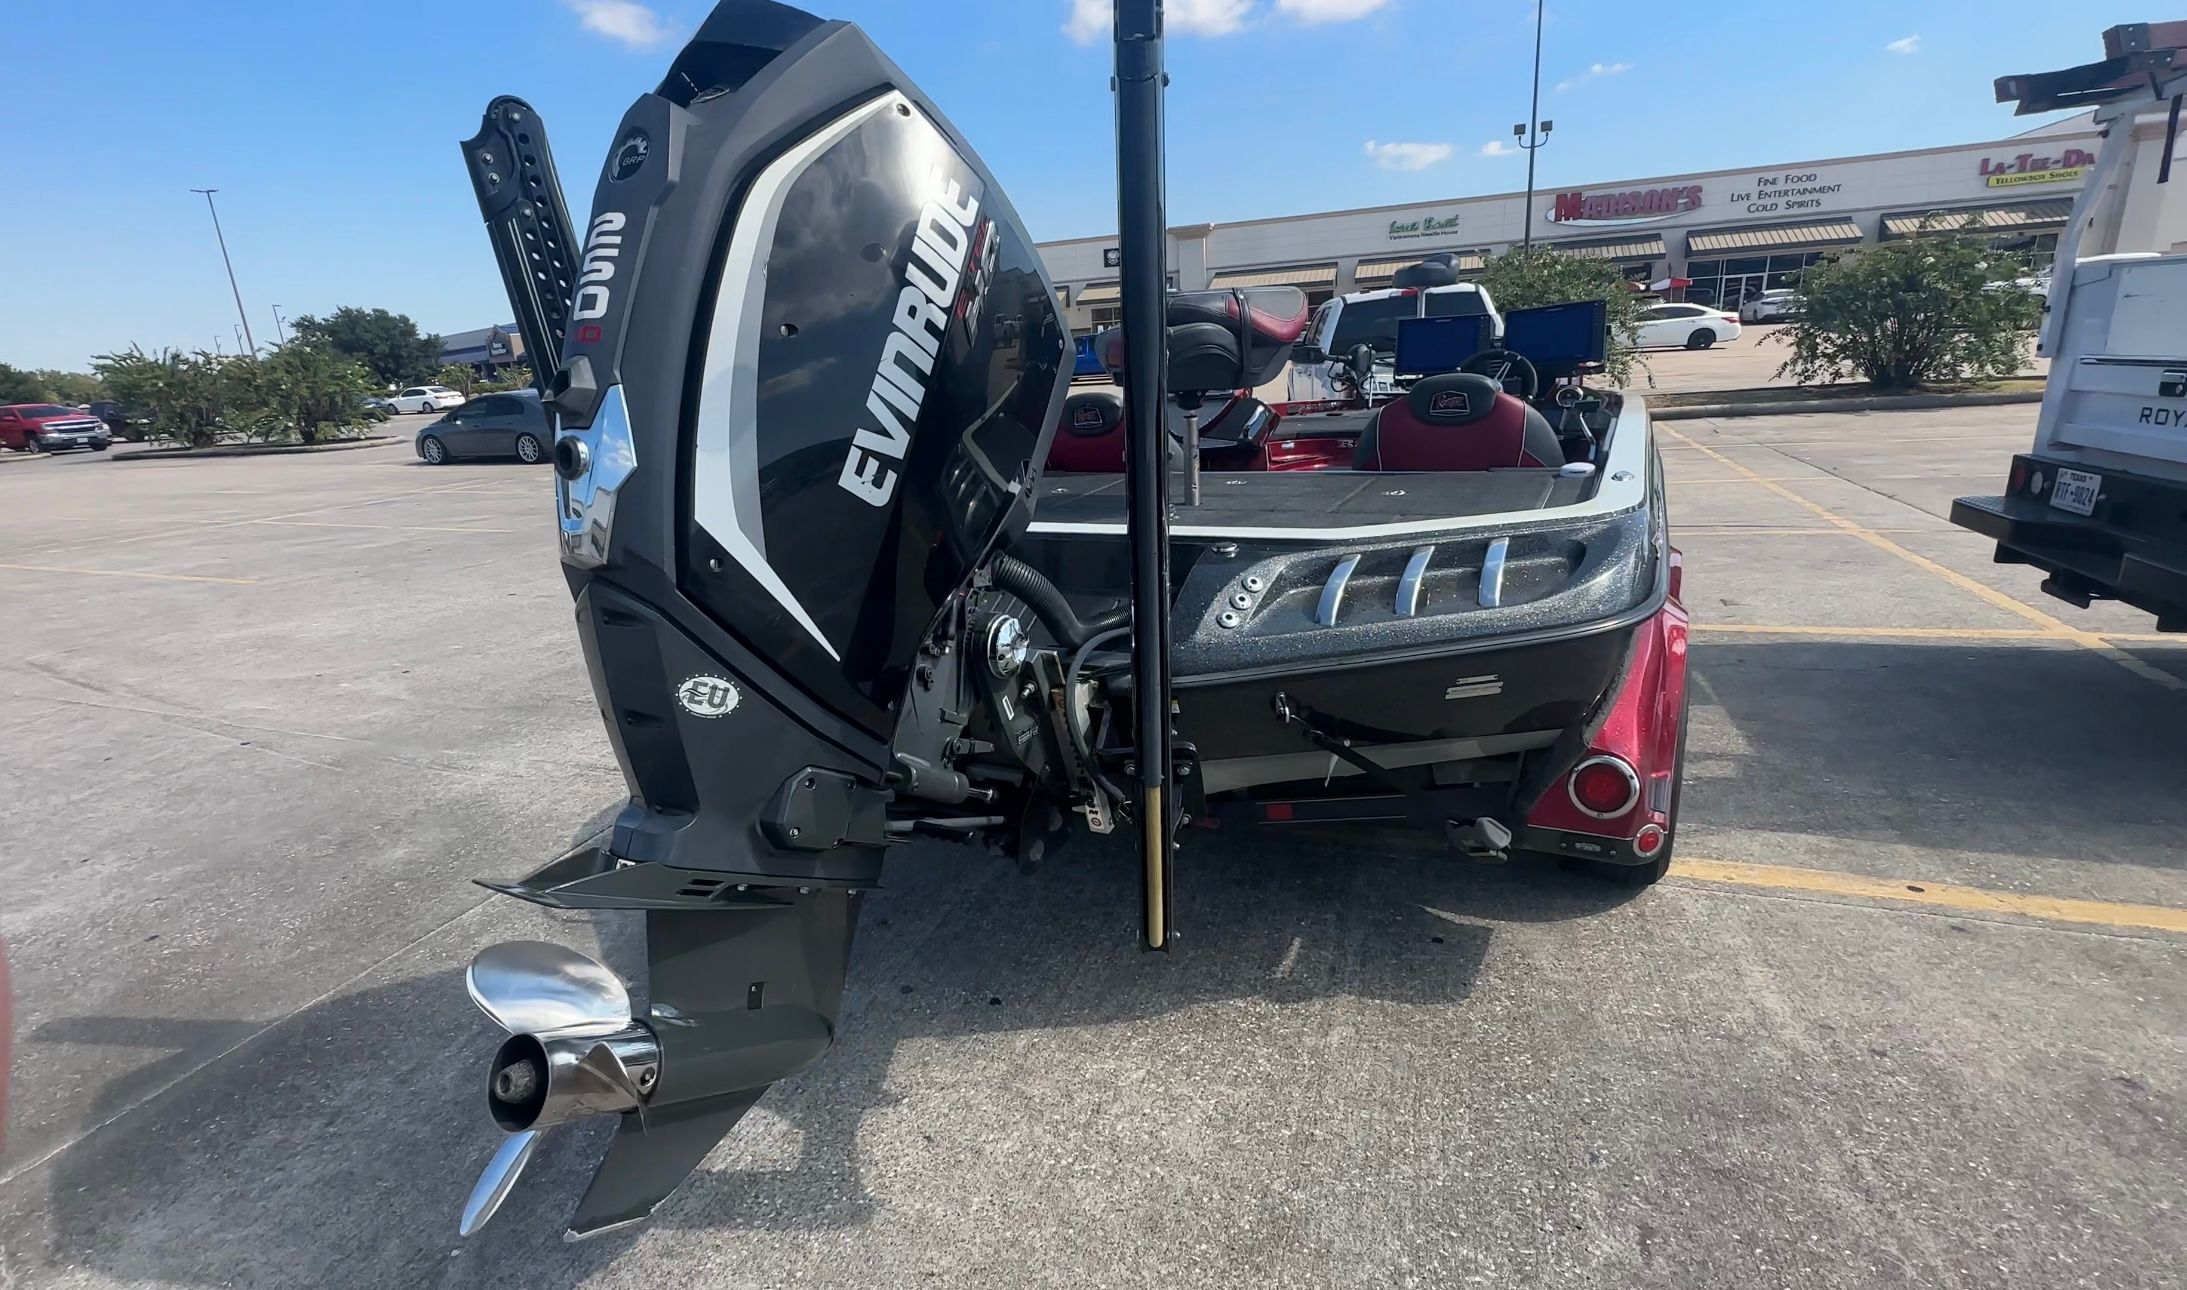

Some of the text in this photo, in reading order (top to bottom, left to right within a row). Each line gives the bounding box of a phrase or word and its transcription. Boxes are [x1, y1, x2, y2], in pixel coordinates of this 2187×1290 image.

[622, 155, 646, 166] BRP
[1757, 174, 1817, 187] FINE FOOD
[1730, 184, 1842, 202] LIVE ENTERTAINMENT
[1554, 185, 1704, 222] MADISON'S
[1747, 199, 1822, 213] COLD SPIRITS
[837, 166, 980, 508] EVINRUDE
[2139, 406, 2187, 428] ROY
[687, 681, 730, 708] EU
